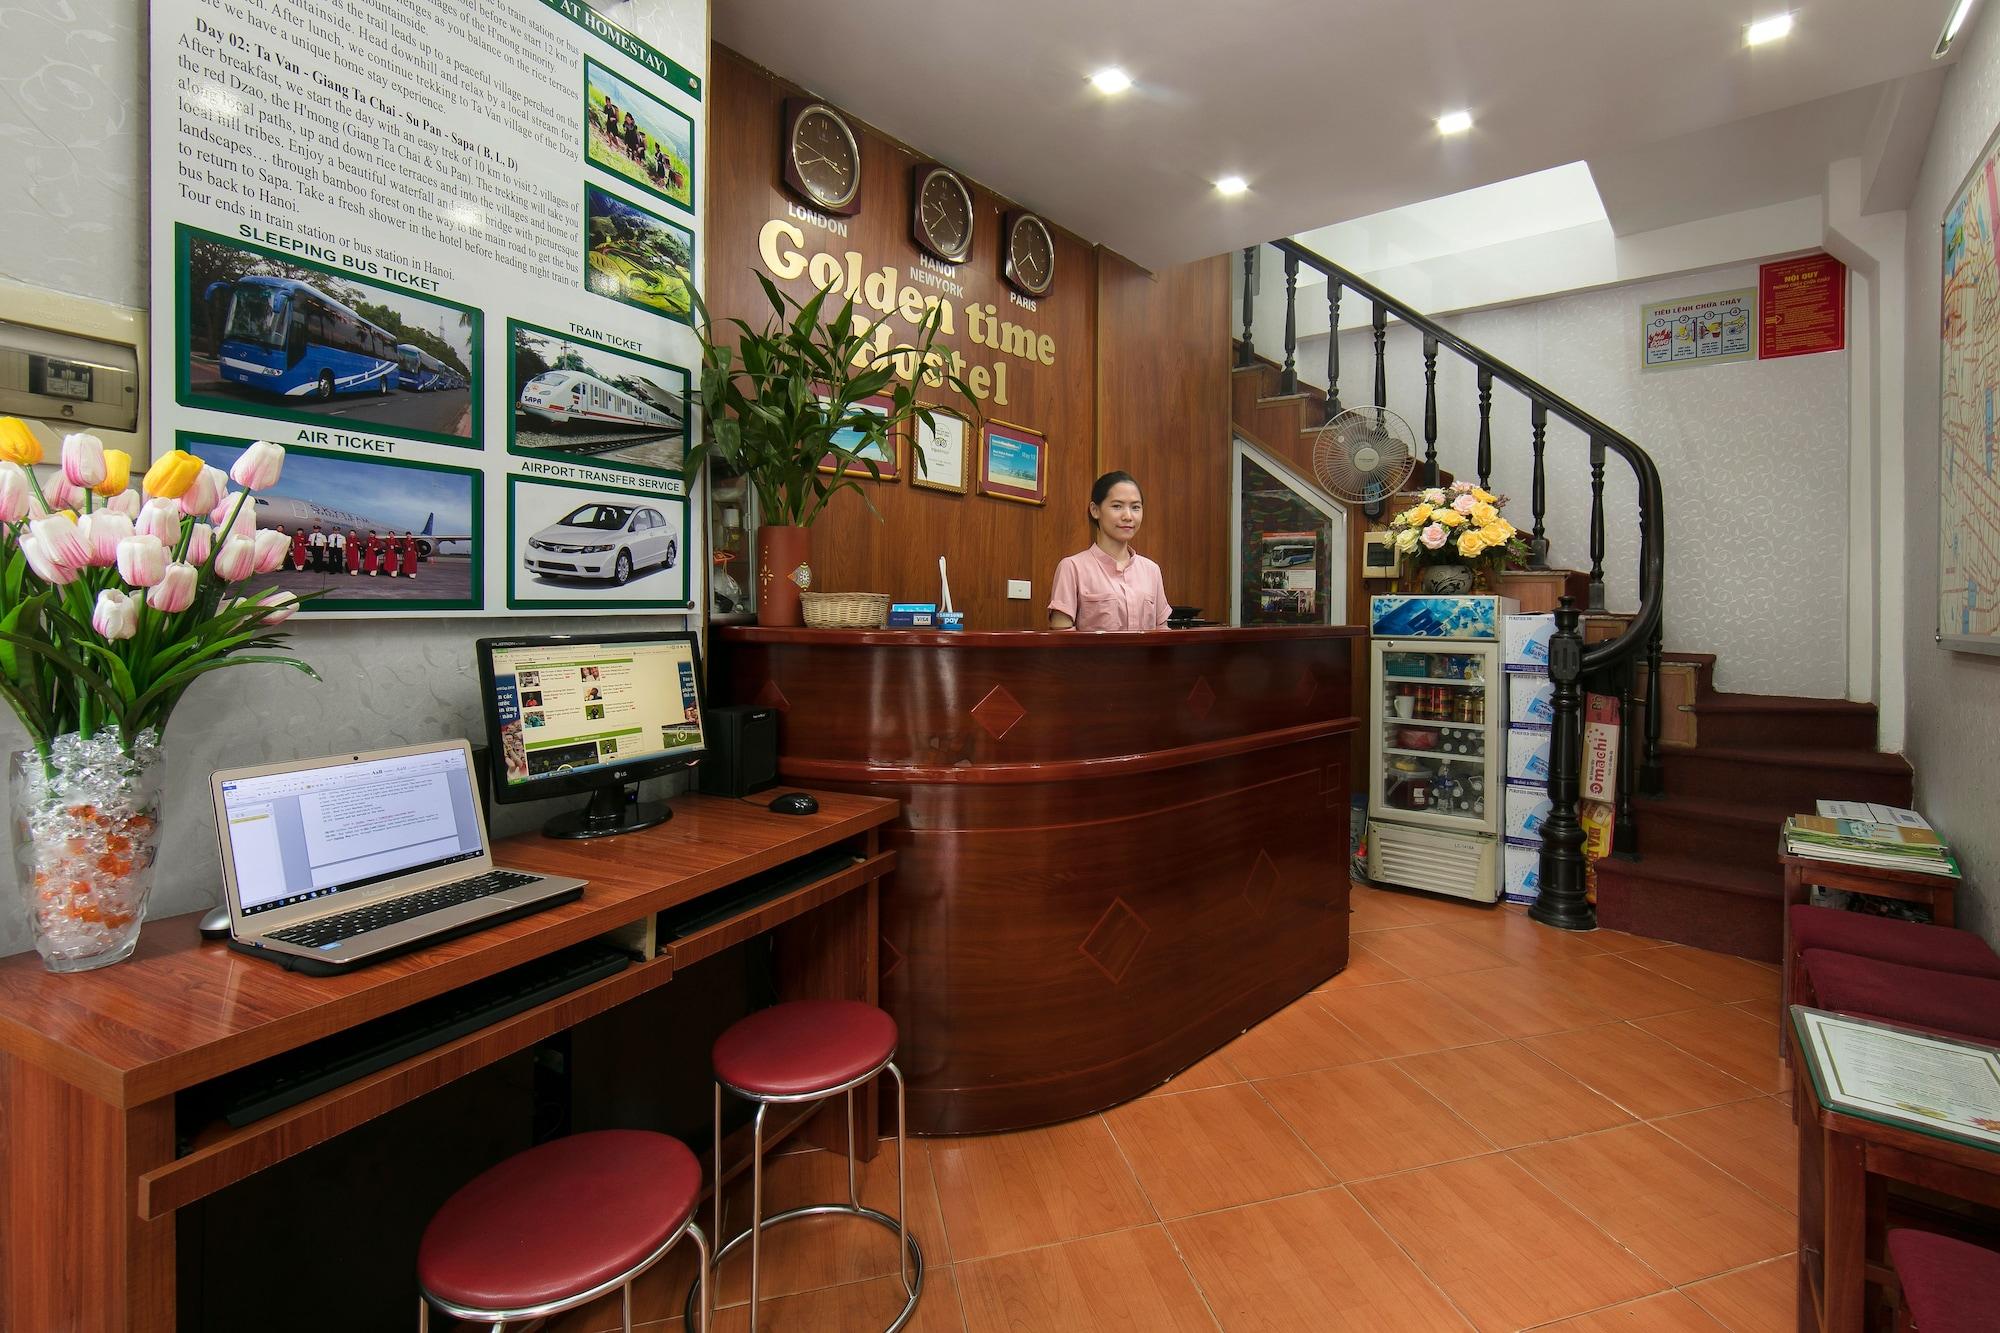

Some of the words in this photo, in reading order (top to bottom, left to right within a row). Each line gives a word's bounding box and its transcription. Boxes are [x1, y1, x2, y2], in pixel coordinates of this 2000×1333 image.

[560, 0, 581, 18] AT
[585, 9, 668, 78] HOMESTAY)
[196, 17, 225, 44] Day
[228, 32, 250, 53] 02:
[254, 43, 271, 62] Ta
[275, 52, 299, 75] Van
[312, 70, 349, 99] Giang
[354, 88, 366, 104] Ta
[369, 96, 395, 117] Chai
[406, 112, 419, 127] Su
[422, 119, 441, 137] Pan
[451, 132, 474, 151] Sapa
[177, 54, 199, 73] the
[203, 66, 225, 84] red
[229, 73, 267, 103] Dzao,
[270, 92, 290, 110] the
[293, 100, 339, 134] H'mong
[342, 121, 379, 150] (Giang
[381, 136, 395, 153] Ta
[397, 144, 421, 164] Chai
[423, 155, 433, 168] &
[435, 159, 448, 175] Su
[450, 165, 473, 186] Pan).
[475, 175, 493, 193] The
[494, 185, 528, 210] trekking
[530, 201, 546, 214] will
[547, 207, 563, 221] take
[563, 215, 579, 228] you
[178, 33, 216, 58] After
[218, 47, 282, 89] breakfast,
[285, 80, 304, 96] we
[306, 89, 331, 108] start
[334, 99, 352, 117] the
[354, 108, 374, 128] day
[376, 119, 400, 137] with
[402, 131, 415, 144] an
[417, 137, 439, 156] easy
[441, 146, 459, 162] trek
[460, 155, 473, 167] of
[474, 158, 485, 172] 10
[486, 163, 501, 180] km
[502, 172, 511, 184] to
[512, 177, 531, 192] visit
[530, 183, 538, 195] 2
[538, 188, 569, 209] villages
[570, 202, 580, 212] of
[178, 160, 203, 181] bus
[206, 169, 239, 193] back
[242, 184, 255, 198] to
[259, 187, 299, 212] Hanoi.
[258, 109, 296, 135] paths,
[299, 125, 315, 142] up
[317, 133, 339, 150] and
[342, 140, 373, 163] down
[375, 154, 396, 172] rice
[398, 164, 438, 188] terraces
[439, 181, 458, 196] and
[459, 186, 478, 203] into
[480, 195, 494, 210] the
[494, 202, 528, 223] villages
[530, 217, 545, 230] and
[546, 220, 568, 239] home
[568, 232, 579, 243] of
[271, 152, 319, 181] through
[322, 169, 367, 197] bamboo
[370, 187, 400, 210] forest
[402, 203, 415, 215] on
[417, 205, 433, 221] the
[435, 214, 455, 231] way
[457, 221, 467, 233] to
[468, 225, 483, 239] the
[484, 232, 506, 247] main
[507, 240, 527, 254] road
[528, 247, 537, 258] to
[537, 252, 550, 264] get
[552, 254, 564, 268] the
[565, 258, 579, 273] bus
[178, 141, 192, 156] to
[196, 149, 237, 172] return
[241, 163, 254, 177] to
[258, 167, 292, 191] Sapa.
[295, 180, 325, 201] Take
[327, 195, 334, 205] a
[337, 194, 365, 216] fresh
[368, 206, 406, 229] shower
[408, 218, 419, 234] in
[421, 224, 436, 240] the
[438, 229, 462, 248] hotel
[464, 238, 493, 259] before
[494, 249, 528, 274] heading
[529, 263, 550, 278] night
[551, 271, 569, 285] train
[570, 279, 579, 288] or
[178, 182, 211, 205] Tour
[214, 198, 246, 216] ends
[249, 204, 262, 221] in
[265, 212, 294, 231] train
[296, 223, 335, 244] station
[338, 237, 351, 248] or
[352, 237, 372, 255] bus
[374, 248, 408, 266] station
[411, 256, 421, 270] in
[423, 260, 454, 280] Hanoi.
[788, 202, 848, 238] LONDON
[239, 224, 336, 262] SLEEPING
[342, 254, 378, 274] BUS
[383, 266, 440, 292] TICKET
[758, 219, 955, 336] Golden
[965, 302, 1056, 366] time
[910, 266, 964, 299] NEWYORK
[920, 253, 956, 279] HANOI
[569, 322, 603, 341] TRAIN
[606, 333, 642, 352] TICKET
[1010, 291, 1038, 312] PARIS
[850, 314, 1008, 406] Hostel
[524, 395, 542, 405] SAPA
[297, 430, 328, 444] AIR
[334, 434, 395, 452] TICKET
[522, 461, 576, 478] AIRPORT
[579, 469, 636, 486] TRANSFER
[638, 478, 680, 492] SERVICE
